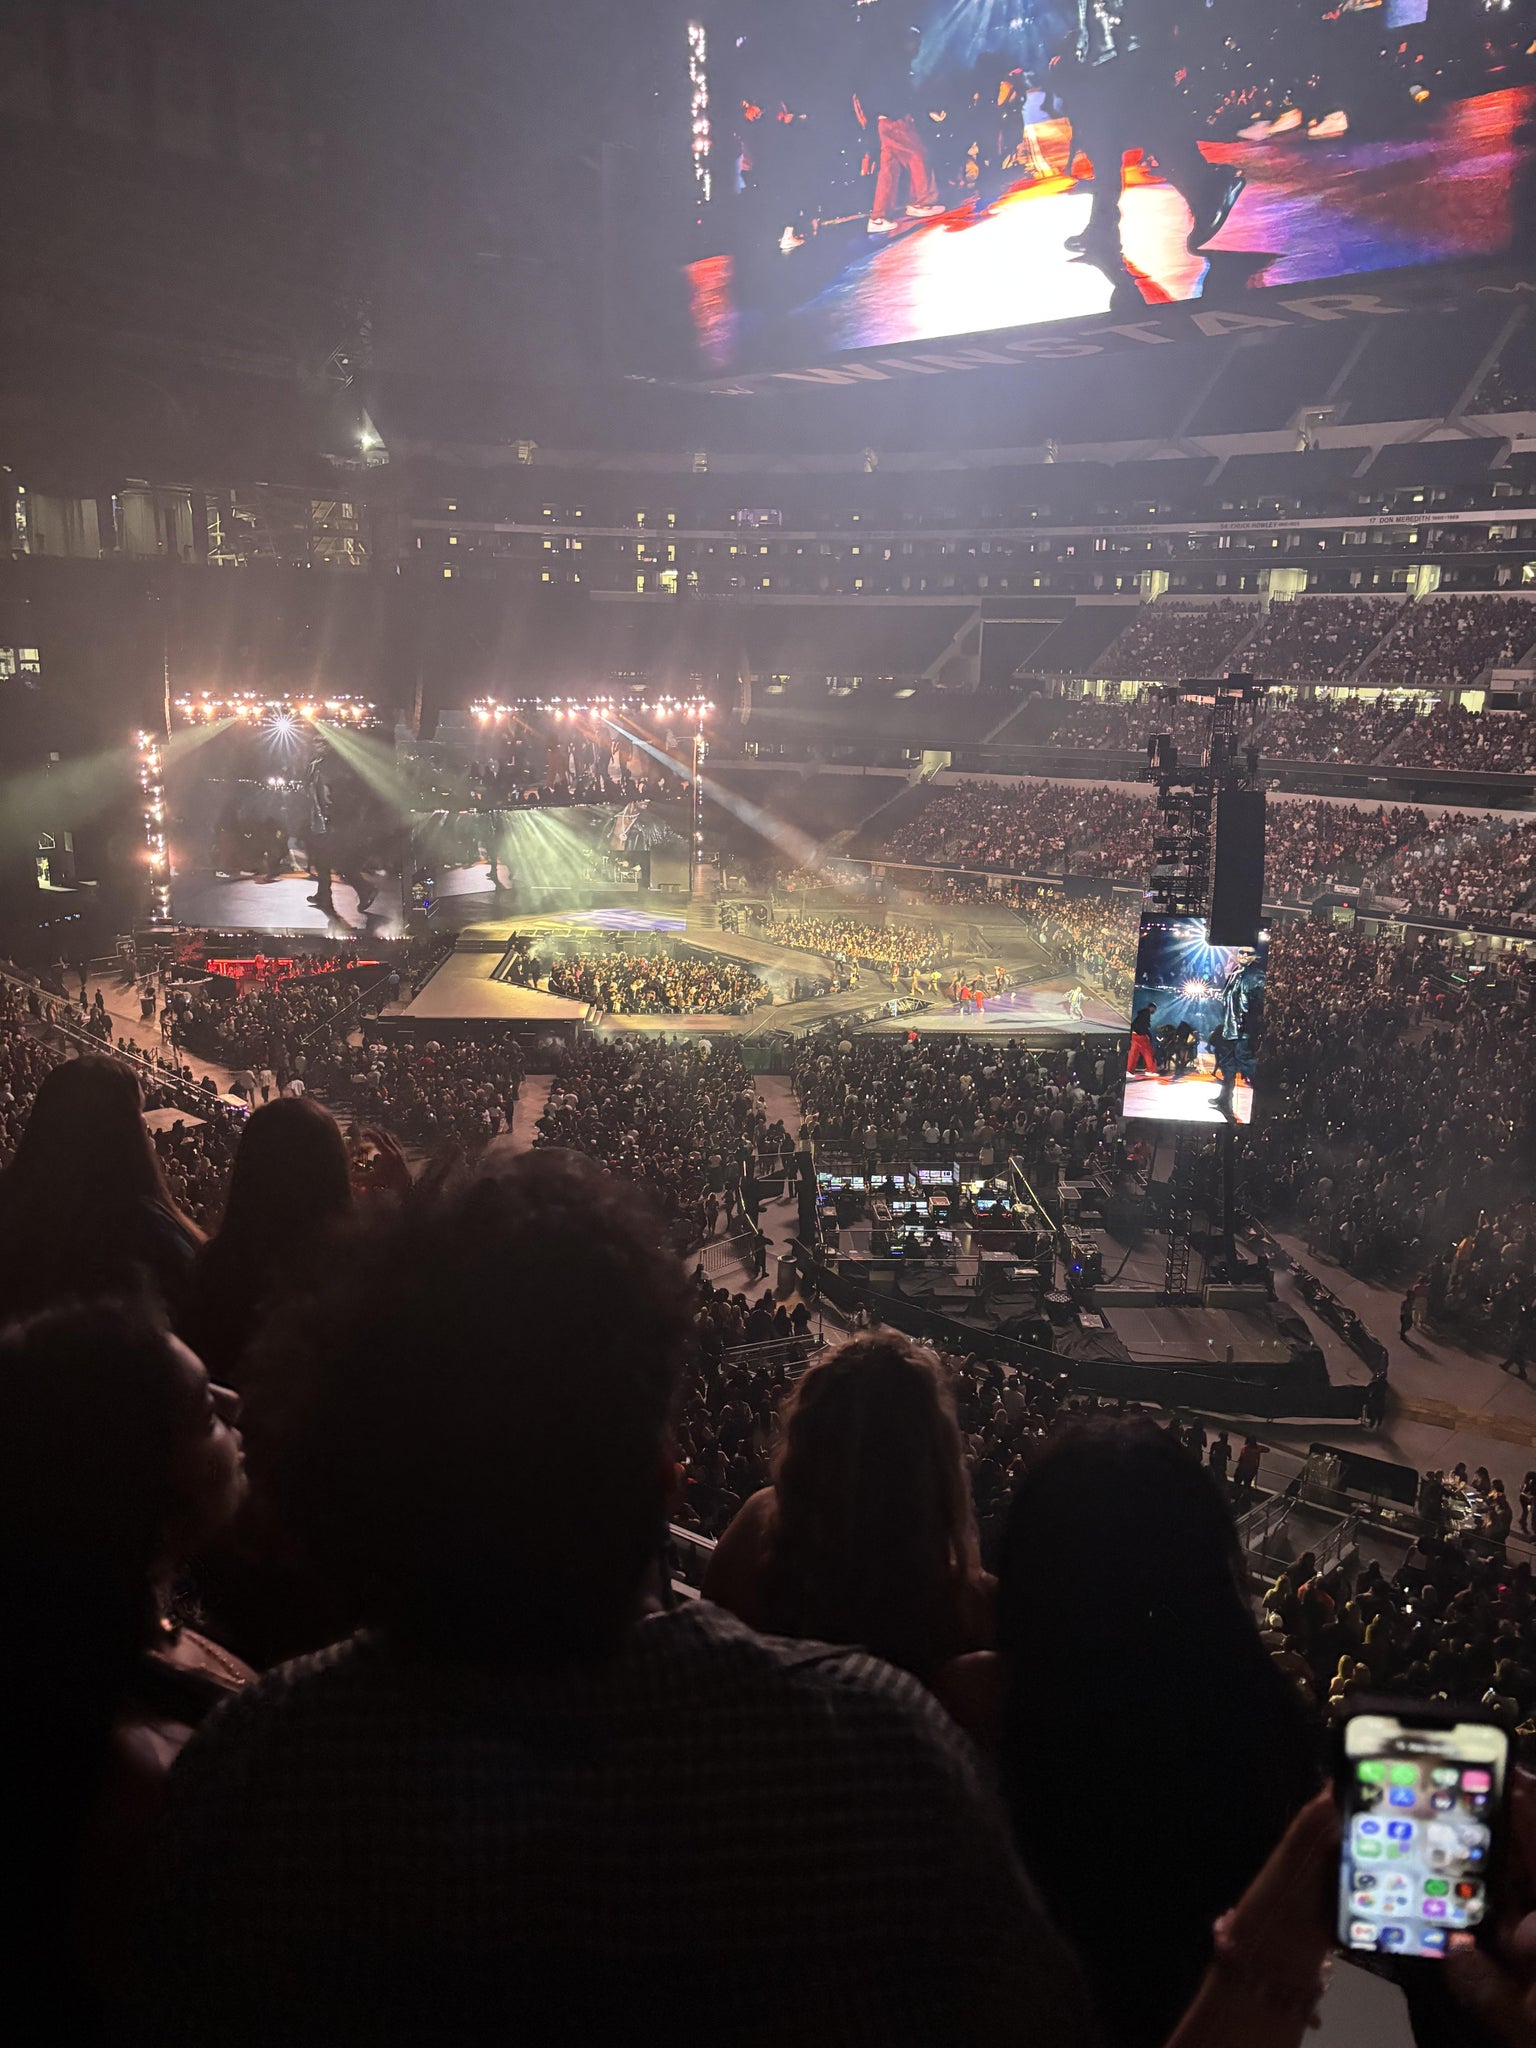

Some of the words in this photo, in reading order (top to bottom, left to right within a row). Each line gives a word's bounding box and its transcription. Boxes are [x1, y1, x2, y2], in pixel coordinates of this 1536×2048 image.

[772, 293, 1409, 386] WINSTAR
[1395, 515, 1431, 523] MEREDITH
[1251, 521, 1277, 529] HOWLEY
